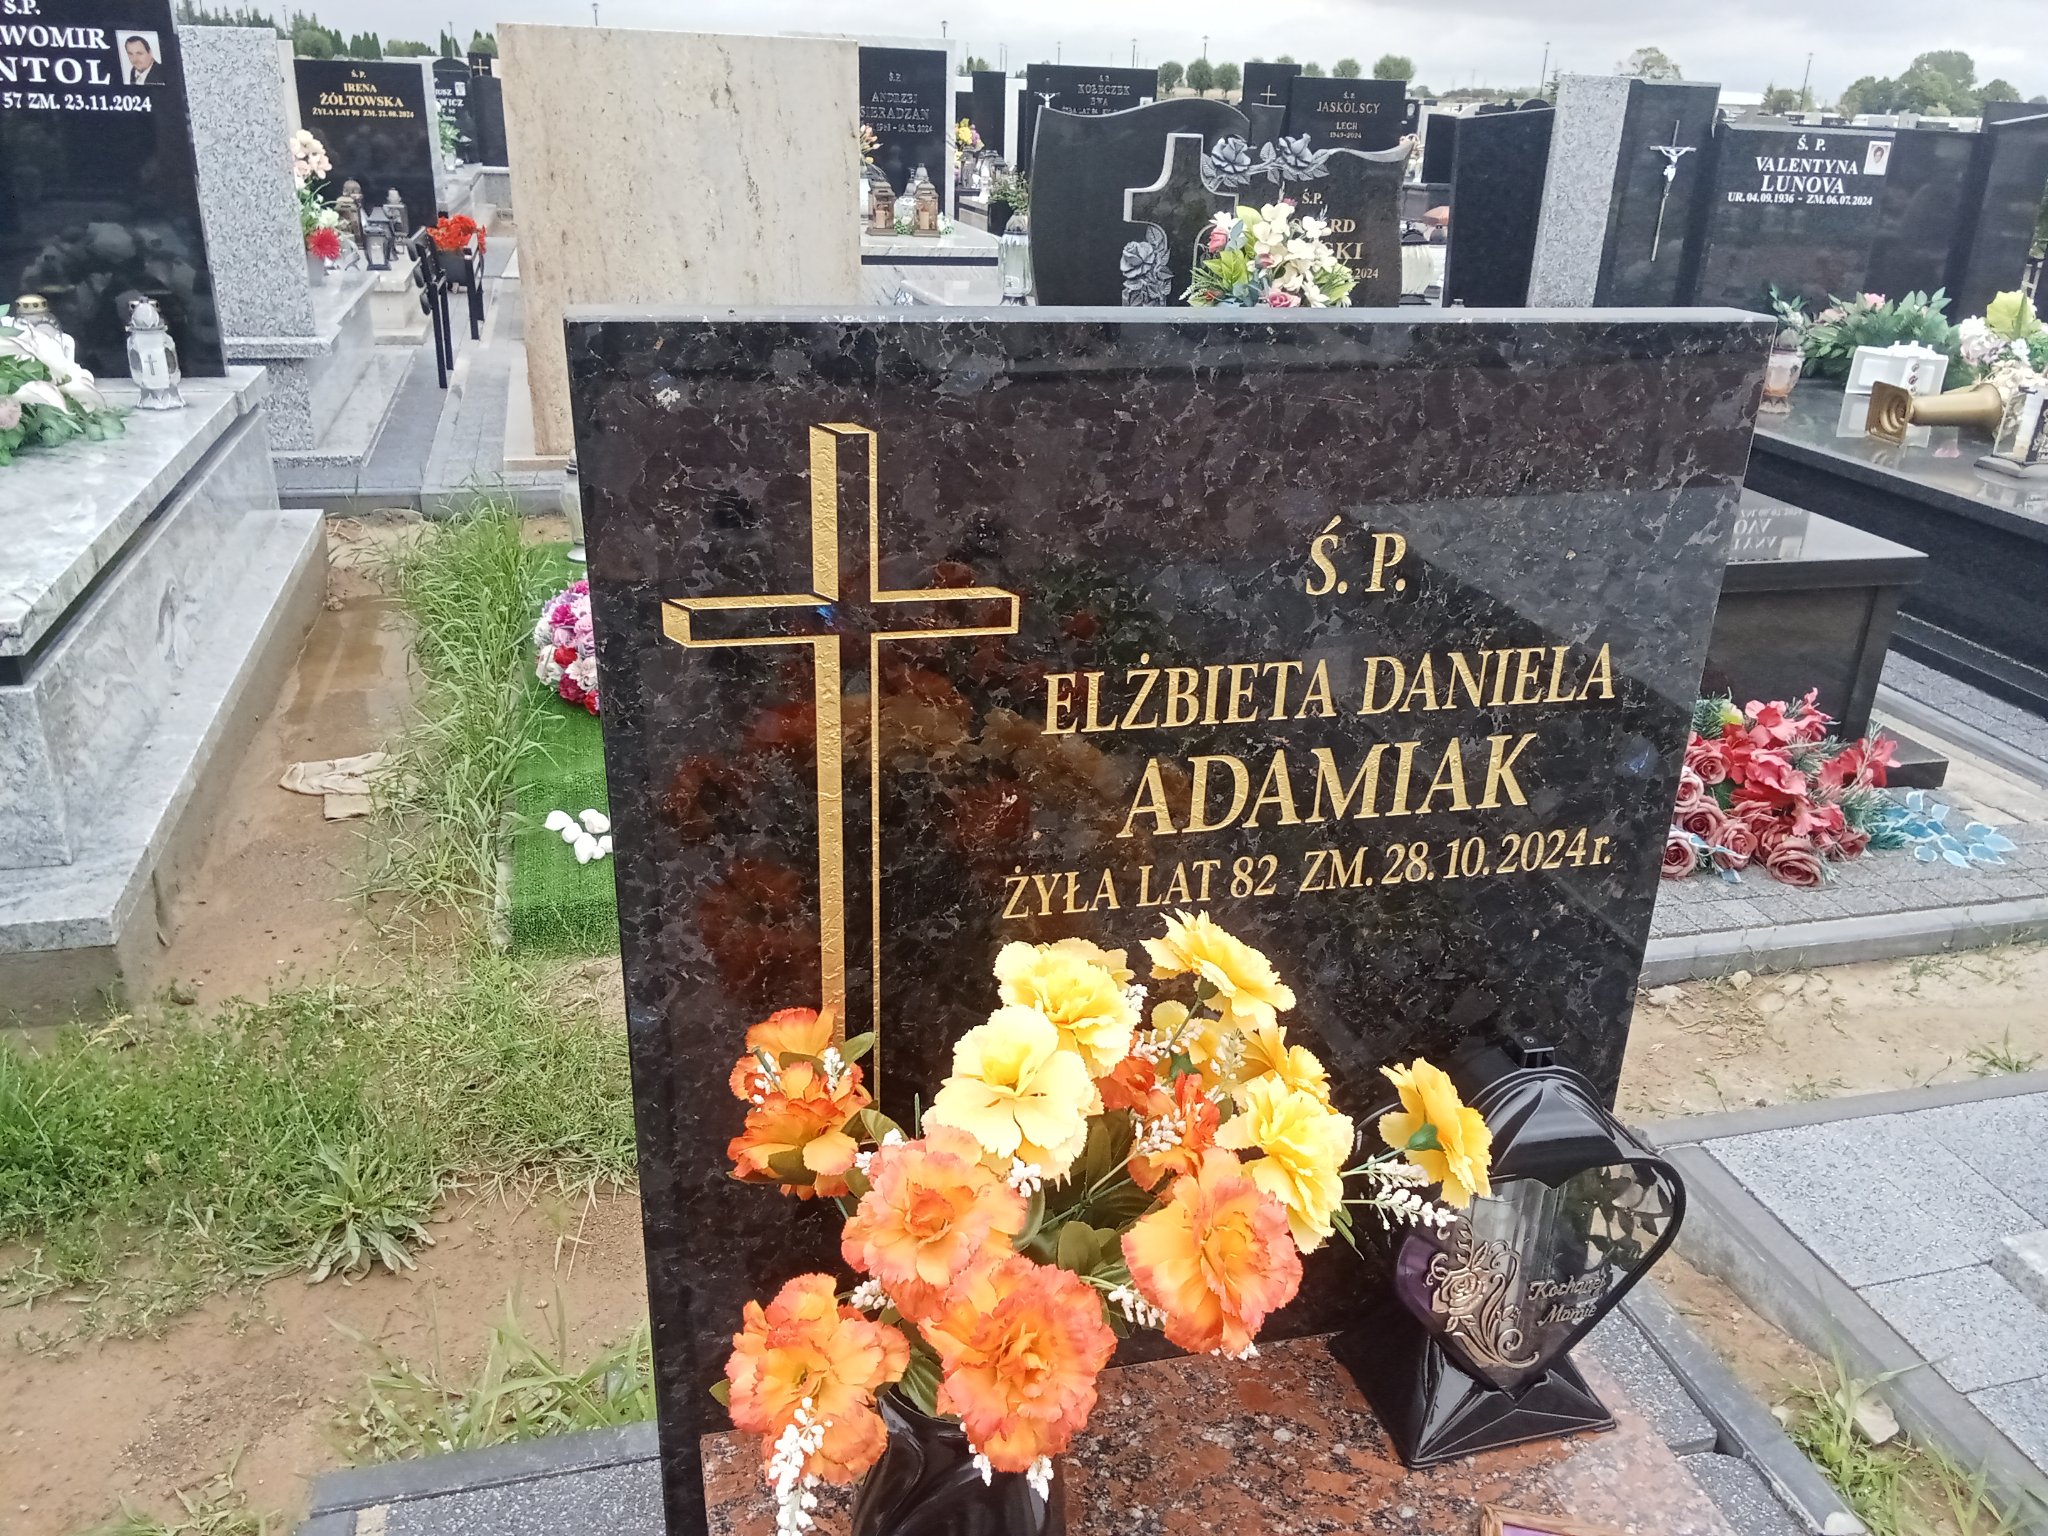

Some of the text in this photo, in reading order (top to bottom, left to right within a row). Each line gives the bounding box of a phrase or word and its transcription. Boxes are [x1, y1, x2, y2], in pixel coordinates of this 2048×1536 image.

[0, 25, 111, 49] WOMIR
[343, 83, 377, 93] IRENA
[871, 91, 918, 104] ANDRZEJ
[2, 92, 153, 112] 57 ZM. 23.11.2024
[319, 92, 404, 107] ŻÓŁTOWSKA
[438, 98, 464, 107] WICZ
[335, 108, 351, 117] LAT
[1336, 121, 1358, 130] LECH
[1755, 156, 1859, 175] VALENTYNA
[1761, 175, 1845, 194] LUNOVA
[1041, 642, 1616, 736] ELŻBIETA DANIELA
[1116, 732, 1539, 838] ADAMIAK
[1002, 865, 1121, 919] ŻYŁA
[1136, 858, 1221, 908] LAT
[1230, 854, 1279, 899] 82
[1300, 846, 1374, 892] ZM.
